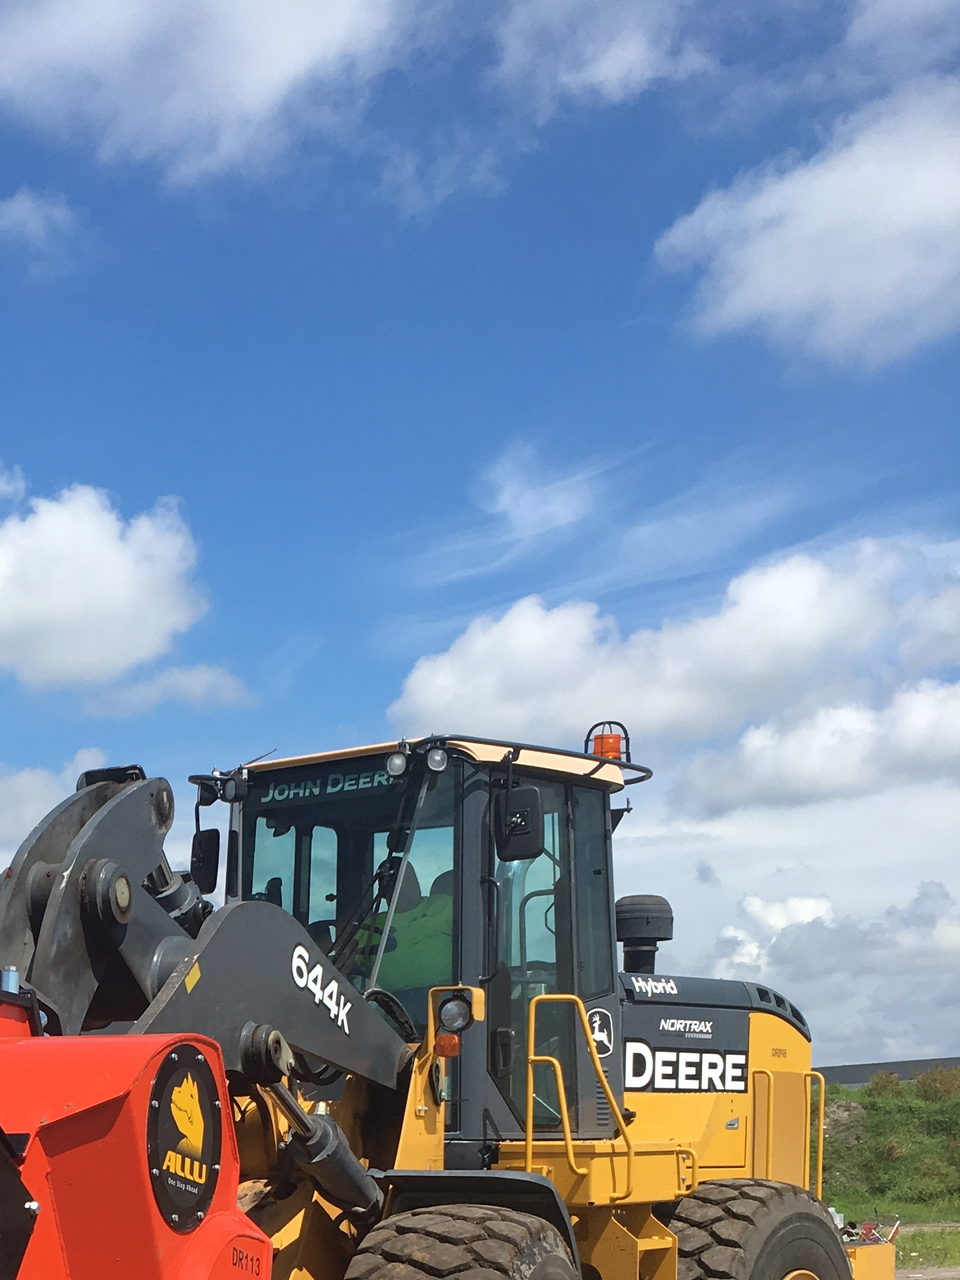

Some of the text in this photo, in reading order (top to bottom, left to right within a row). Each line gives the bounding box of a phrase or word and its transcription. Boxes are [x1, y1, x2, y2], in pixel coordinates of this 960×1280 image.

[261, 770, 394, 803] JOHN DEER
[292, 945, 352, 1035] 644K
[631, 976, 678, 997] Hybrid
[659, 1018, 713, 1033] NORTRAX
[624, 1041, 746, 1091] DEERE
[162, 1150, 207, 1184] ALLU
[167, 1177, 176, 1186] One
[176, 1180, 186, 1191] Step
[232, 1246, 261, 1276] DR113
